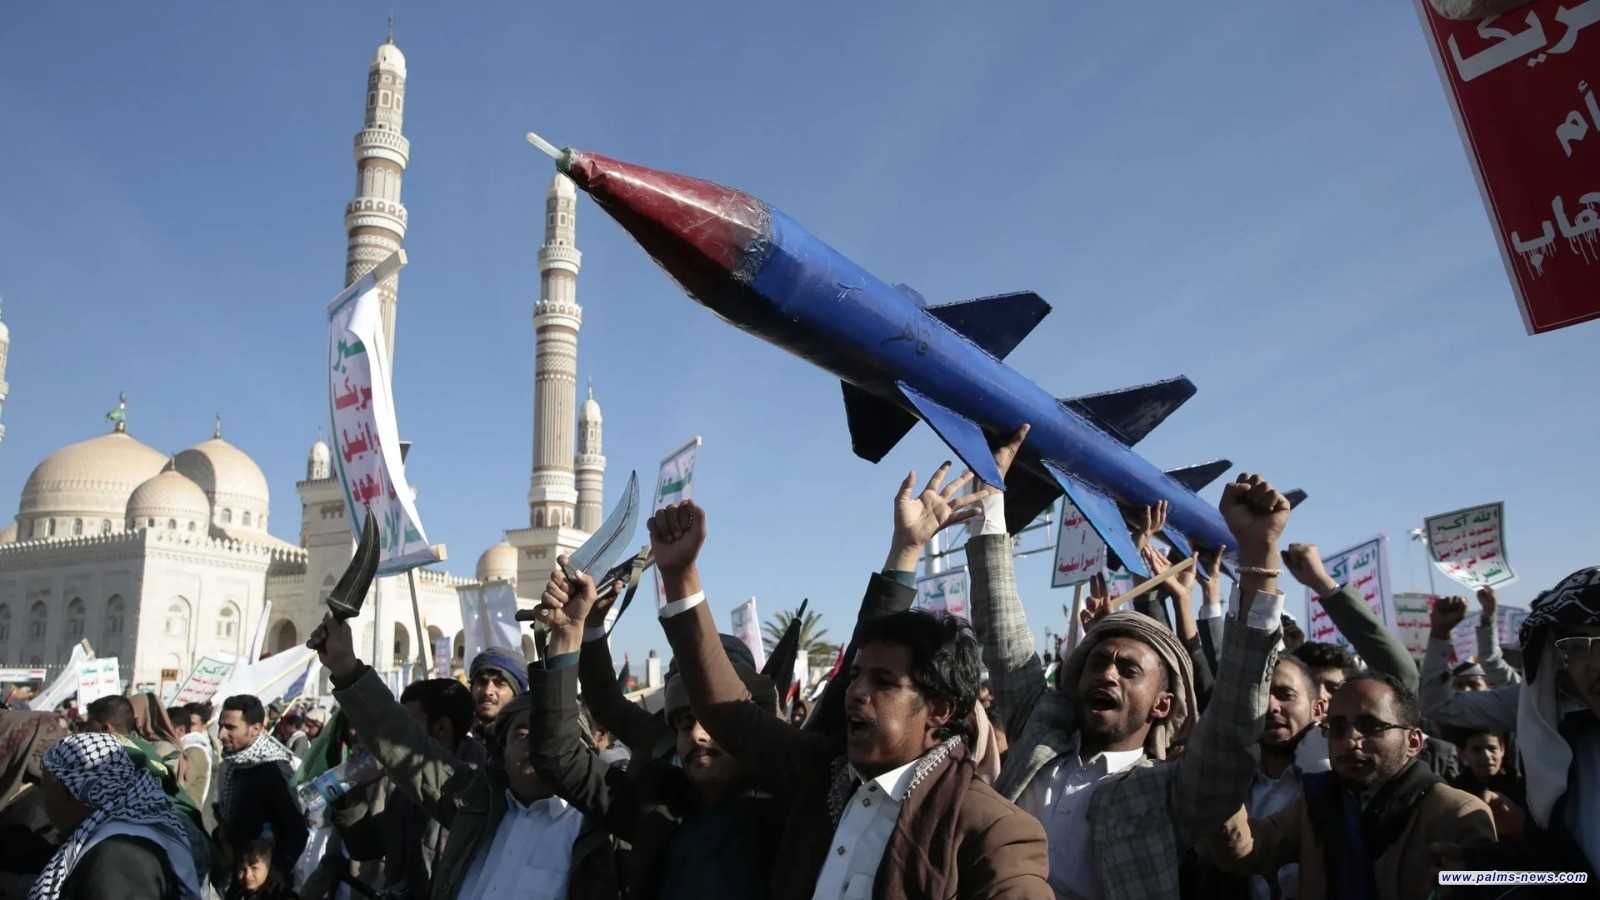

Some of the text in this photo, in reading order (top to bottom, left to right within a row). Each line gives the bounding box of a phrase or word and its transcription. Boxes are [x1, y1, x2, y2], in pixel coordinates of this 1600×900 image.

[332, 336, 366, 375] بر
[333, 375, 373, 411] ريكا
[1432, 509, 1497, 536] الله أكبر
[1330, 549, 1375, 578] الله أك
